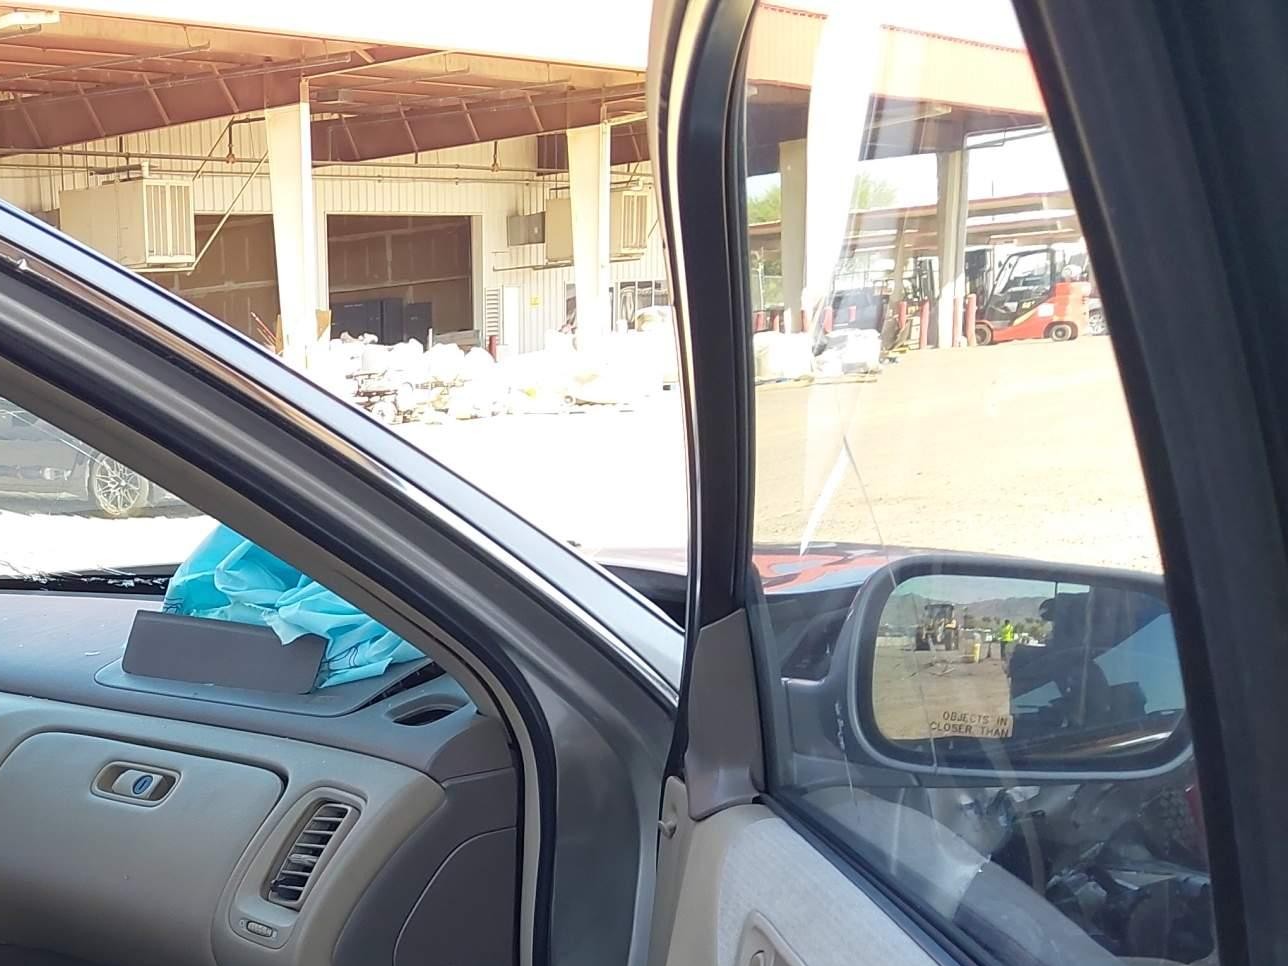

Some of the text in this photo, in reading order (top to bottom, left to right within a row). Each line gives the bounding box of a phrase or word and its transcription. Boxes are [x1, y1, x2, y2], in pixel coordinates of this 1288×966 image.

[942, 711, 1008, 726] OBJECTS IN
[929, 721, 1009, 737] CLOSER THAN
